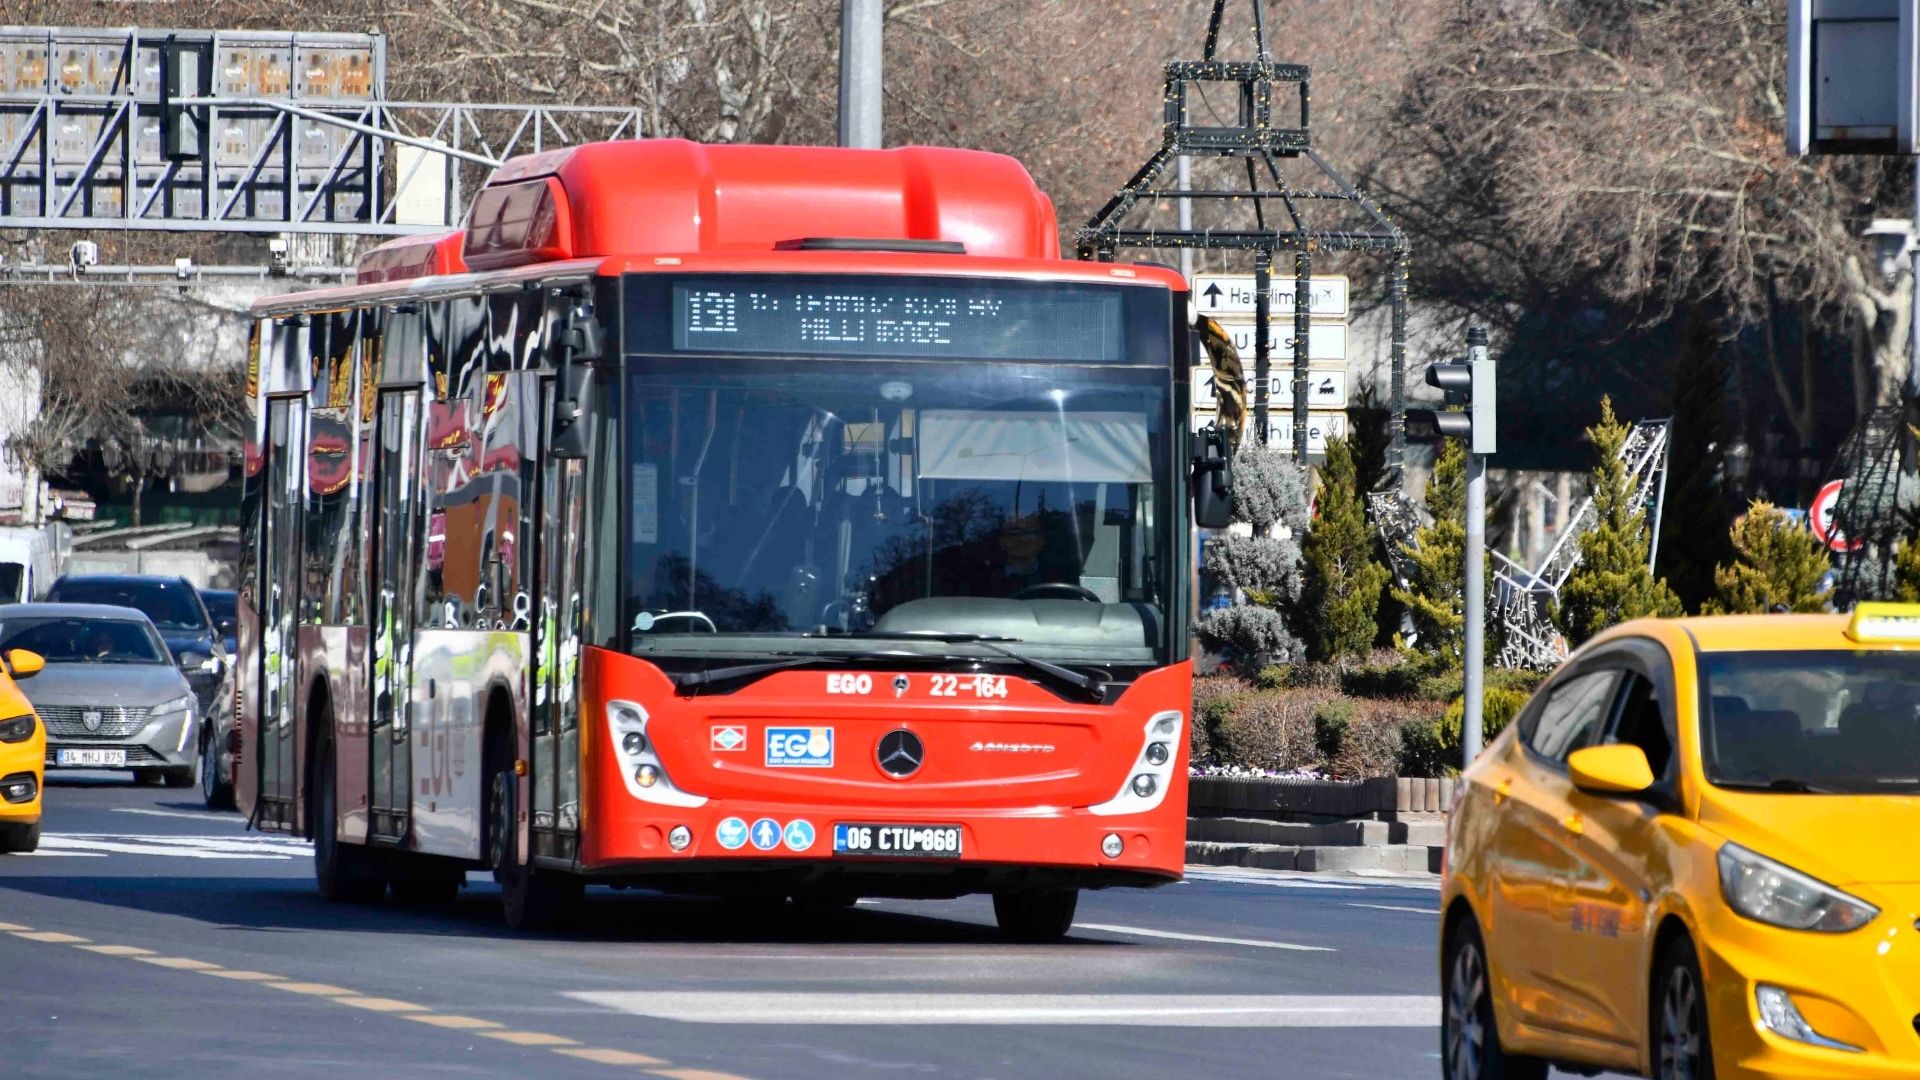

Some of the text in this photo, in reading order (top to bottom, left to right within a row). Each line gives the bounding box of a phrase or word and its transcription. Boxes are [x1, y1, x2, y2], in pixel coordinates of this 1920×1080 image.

[1234, 333, 1296, 350] Uus
[826, 673, 1008, 698] EGO 22-164
[64, 751, 123, 763] 34 MHJ 875
[847, 827, 957, 852] 06 CTU 868
